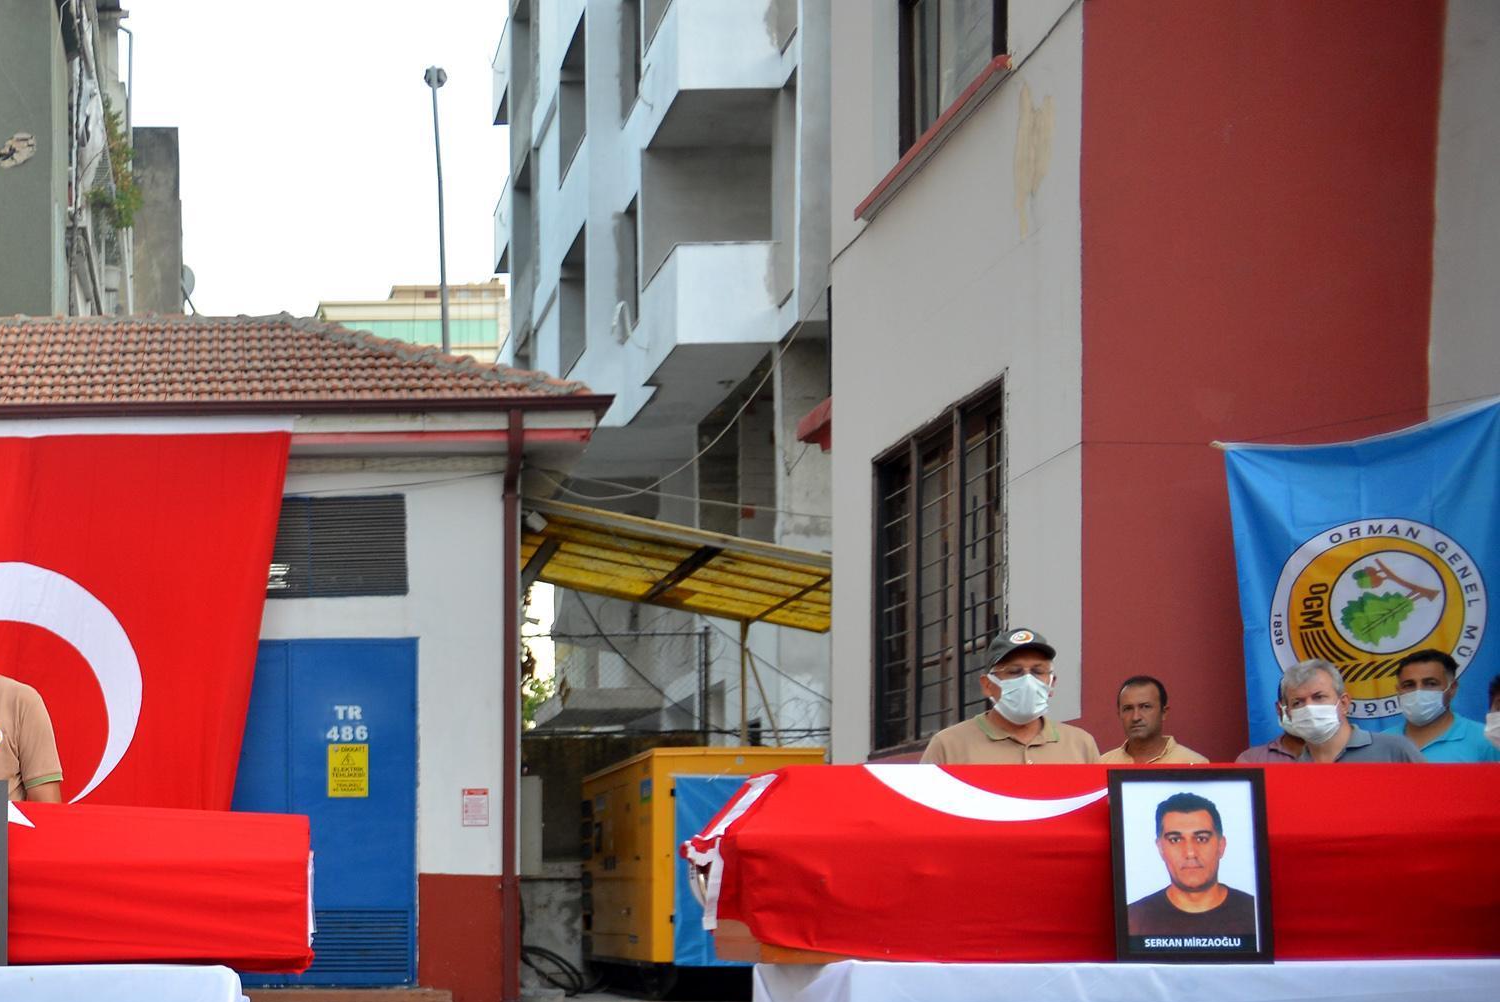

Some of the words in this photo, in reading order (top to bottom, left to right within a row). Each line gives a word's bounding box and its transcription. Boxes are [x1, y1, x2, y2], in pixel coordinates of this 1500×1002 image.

[1329, 524, 1420, 544] ORMAN
[1434, 541, 1481, 608] GENEL
[1300, 582, 1329, 630] OGM
[1273, 613, 1284, 645] 1839
[334, 705, 363, 720] TR
[326, 725, 368, 741] 486
[1144, 938, 1182, 948] SERKAN
[1183, 936, 1241, 948] MİRZAOĞLU
